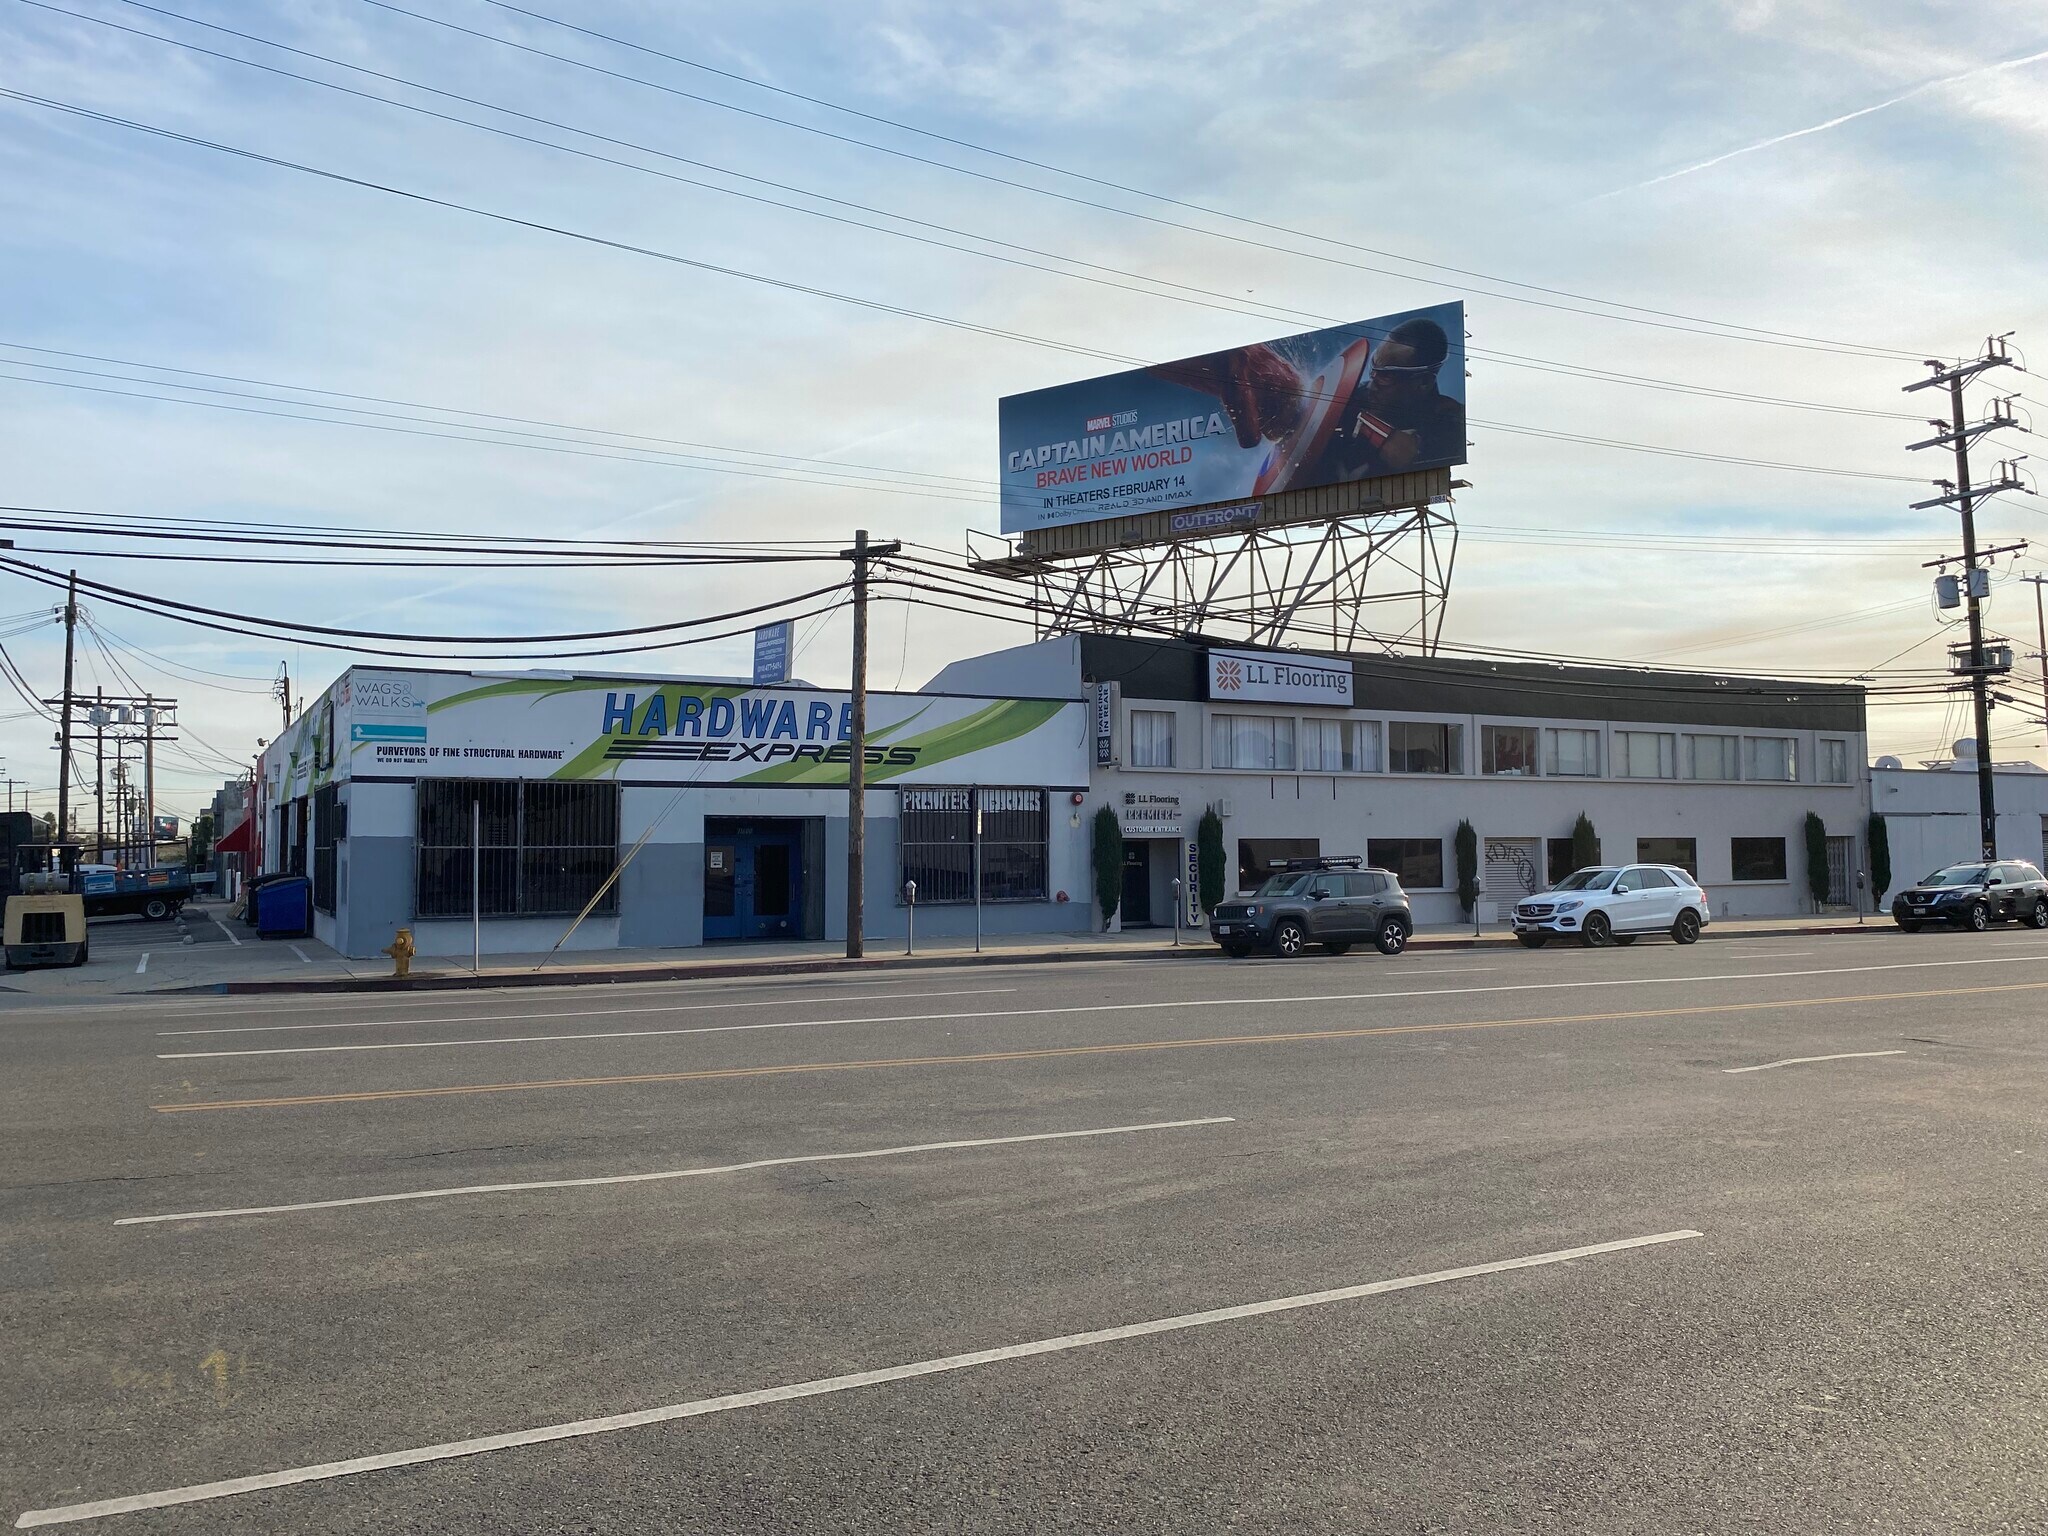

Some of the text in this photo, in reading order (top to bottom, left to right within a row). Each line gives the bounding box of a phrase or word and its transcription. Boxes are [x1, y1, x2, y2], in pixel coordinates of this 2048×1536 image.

[1087, 411, 1138, 431] MARVEL STUDIOS
[1007, 412, 1226, 473] CAPTAIN AMERICA
[1036, 446, 1192, 489] BRAVE NEW WORLD
[1043, 475, 1186, 509] IN THEATERS FEBRUARY 14
[1055, 511, 1072, 520] Dolby
[1146, 495, 1163, 504] AND
[1165, 489, 1193, 501] IMAX
[1174, 504, 1256, 529] OUTFRONT
[1246, 664, 1348, 694] LL Flooring
[355, 696, 411, 708] WALKS
[601, 692, 854, 741] HARDWARE
[376, 746, 426, 757] PURVEYORS
[429, 747, 440, 757] OF
[443, 747, 461, 757] FINE
[463, 748, 515, 759] STRUCTURAL
[697, 742, 922, 765] EXPRESS
[1138, 795, 1180, 806] LL Flooring
[1125, 825, 1182, 833] CUSTOMER ENTRANCE
[1188, 843, 1199, 924] SECURITY
